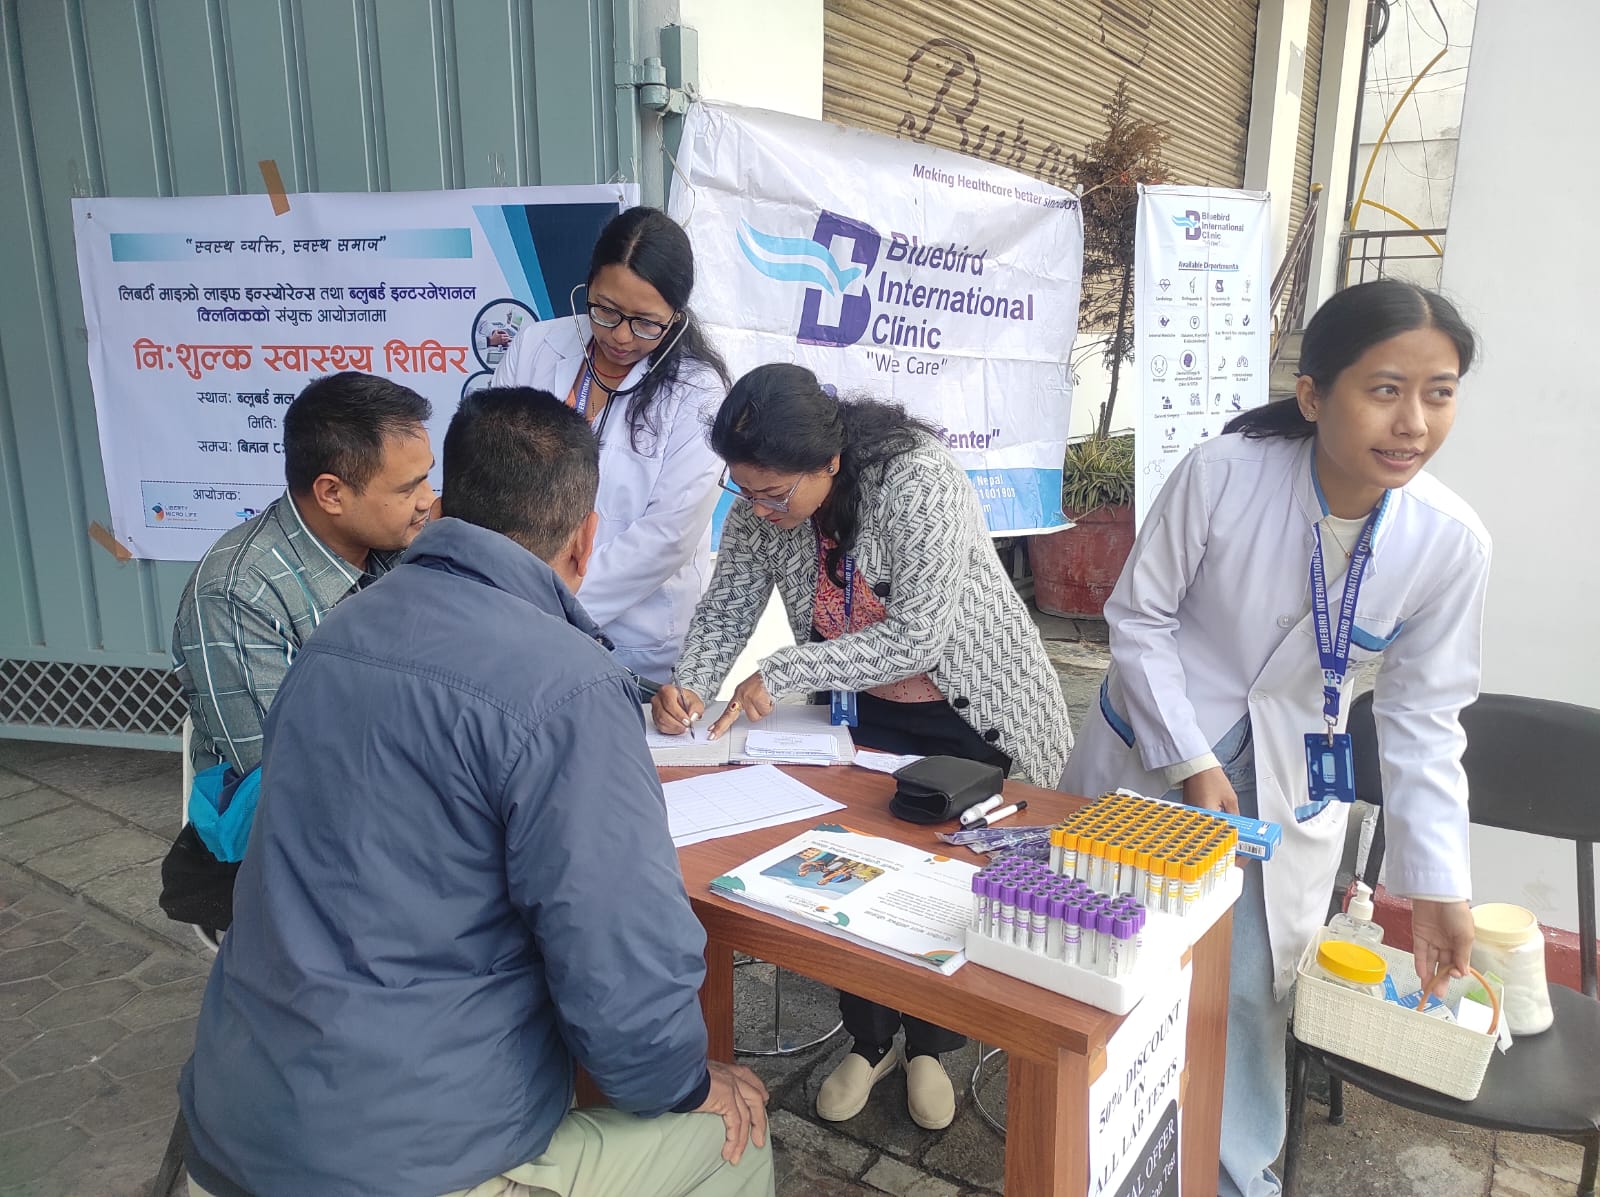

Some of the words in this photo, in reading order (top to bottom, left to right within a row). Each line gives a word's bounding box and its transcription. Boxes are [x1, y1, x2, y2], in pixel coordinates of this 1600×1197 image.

[913, 163, 955, 188] Making
[957, 174, 1013, 199] Healthcare
[1014, 187, 1042, 206] better
[292, 238, 331, 253] स्वस्थ
[886, 231, 986, 277] Bluebird
[118, 283, 154, 302] लिबर्टी
[203, 287, 241, 303] लाइफ
[320, 287, 344, 301] तथा
[389, 283, 477, 302] इन्टरनेशनल
[877, 271, 1034, 321] International
[197, 306, 270, 322] क्लिनिकको
[275, 308, 313, 326] संयुक्त
[317, 306, 387, 323] आयोजनामा
[871, 312, 941, 350] Clinic
[261, 344, 374, 374] स्वास्थ्य
[383, 339, 469, 373] शिविर
[237, 439, 269, 453] बिहान
[1342, 554, 1365, 618] INTERNATIONAL
[1317, 615, 1331, 654] BLUEBIRD
[1335, 619, 1351, 660] BLUEBIRD
[1099, 1086, 1122, 1134] 50%
[1125, 998, 1182, 1093] DISCOUNT
[1123, 1108, 1144, 1157] LAB
[1147, 1056, 1178, 1115] TESTS
[1134, 1075, 1146, 1108] IN
[1145, 1118, 1175, 1178] OFFER
